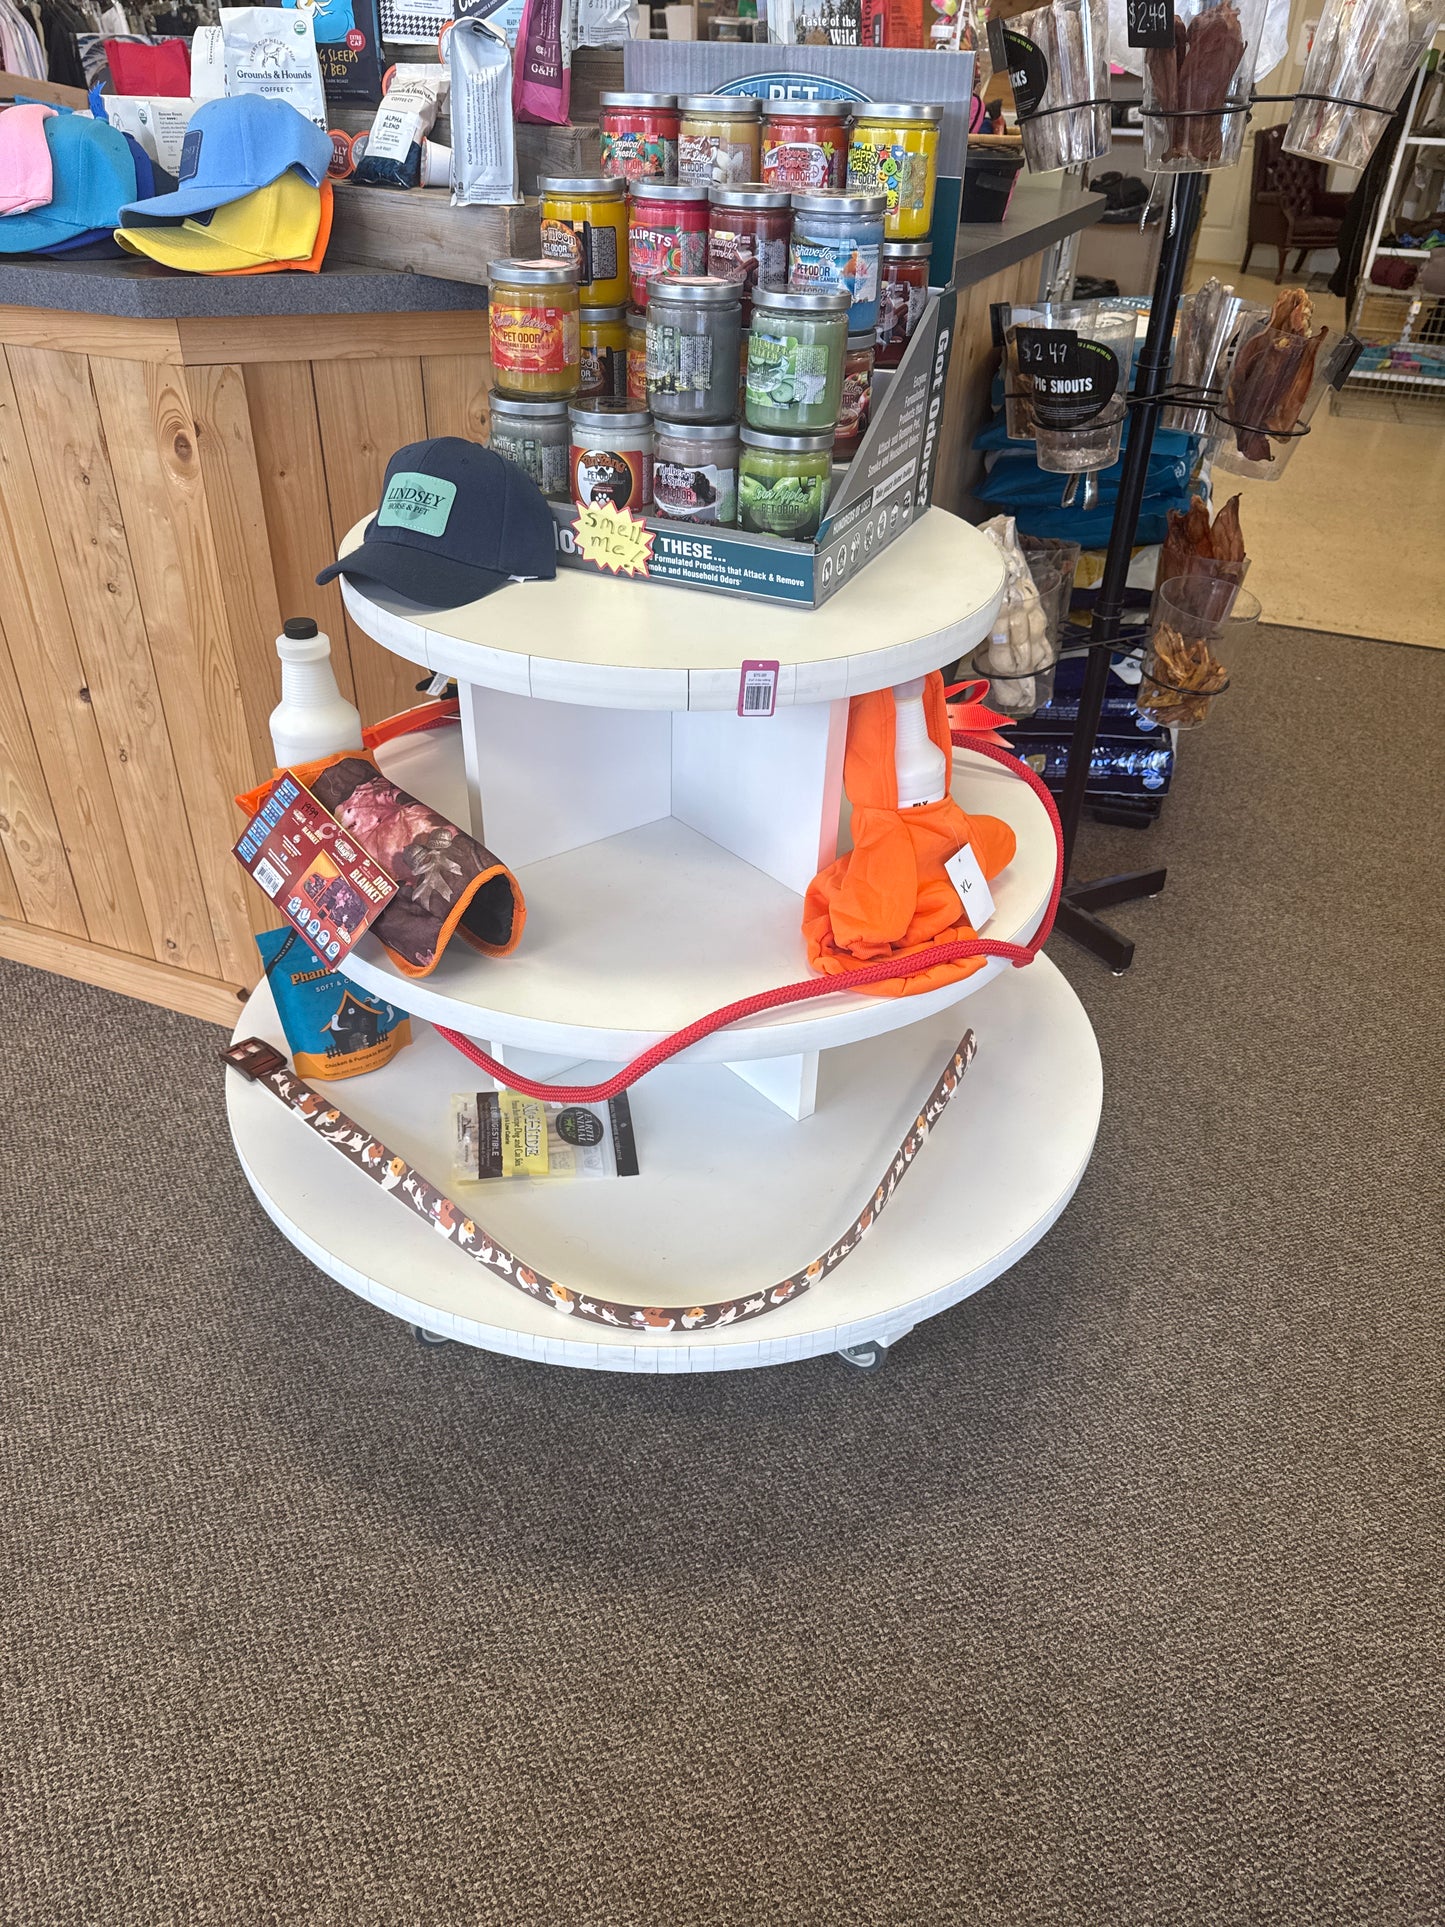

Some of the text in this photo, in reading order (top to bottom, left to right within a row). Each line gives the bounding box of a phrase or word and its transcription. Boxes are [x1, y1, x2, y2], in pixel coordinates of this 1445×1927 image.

[801, 14, 857, 27] Taste of the
[1129, 0, 1167, 33] $2.49
[829, 28, 857, 45] Wild
[325, 49, 359, 63] SLEEPS
[236, 69, 312, 80] Grounds & Hounds
[331, 64, 347, 76] BED
[531, 63, 554, 77] G&H
[769, 84, 820, 100] PET
[382, 121, 400, 130] BLEND
[385, 115, 403, 123] ALPHA
[851, 148, 879, 165] Happy
[687, 162, 704, 172] ODOR
[850, 160, 877, 175] Days
[790, 171, 811, 181] ODOR
[858, 174, 877, 185] ODOR
[550, 243, 568, 253] ODOR
[795, 245, 837, 262] Shave Ice
[796, 263, 831, 277] PET ODOR
[503, 331, 543, 343] PET ODOR
[1034, 375, 1093, 394] PIG SNOUTS
[916, 328, 950, 507] Got Odors?
[493, 439, 516, 453] WHITE
[659, 464, 696, 482] Mulberry
[388, 488, 446, 507] LINDSEY
[388, 502, 405, 510] HORSE
[414, 506, 430, 515] PET
[777, 504, 800, 515] ODOR
[660, 537, 727, 563] THESE...
[654, 554, 805, 588] Formulated Products that Attack & Remove
[668, 565, 682, 577] and
[682, 567, 719, 582] Household
[301, 825, 320, 845] BLANKET
[349, 867, 384, 904] BLANKET
[373, 874, 393, 897] DOG
[960, 879, 973, 894] XL
[290, 966, 336, 985] Phant
[315, 981, 335, 993] SOFT
[324, 1057, 348, 1069] Chicken
[353, 1050, 377, 1063] Pumpkin
[577, 1110, 586, 1142] ANIMAL
[584, 1113, 594, 1142] EARTH
